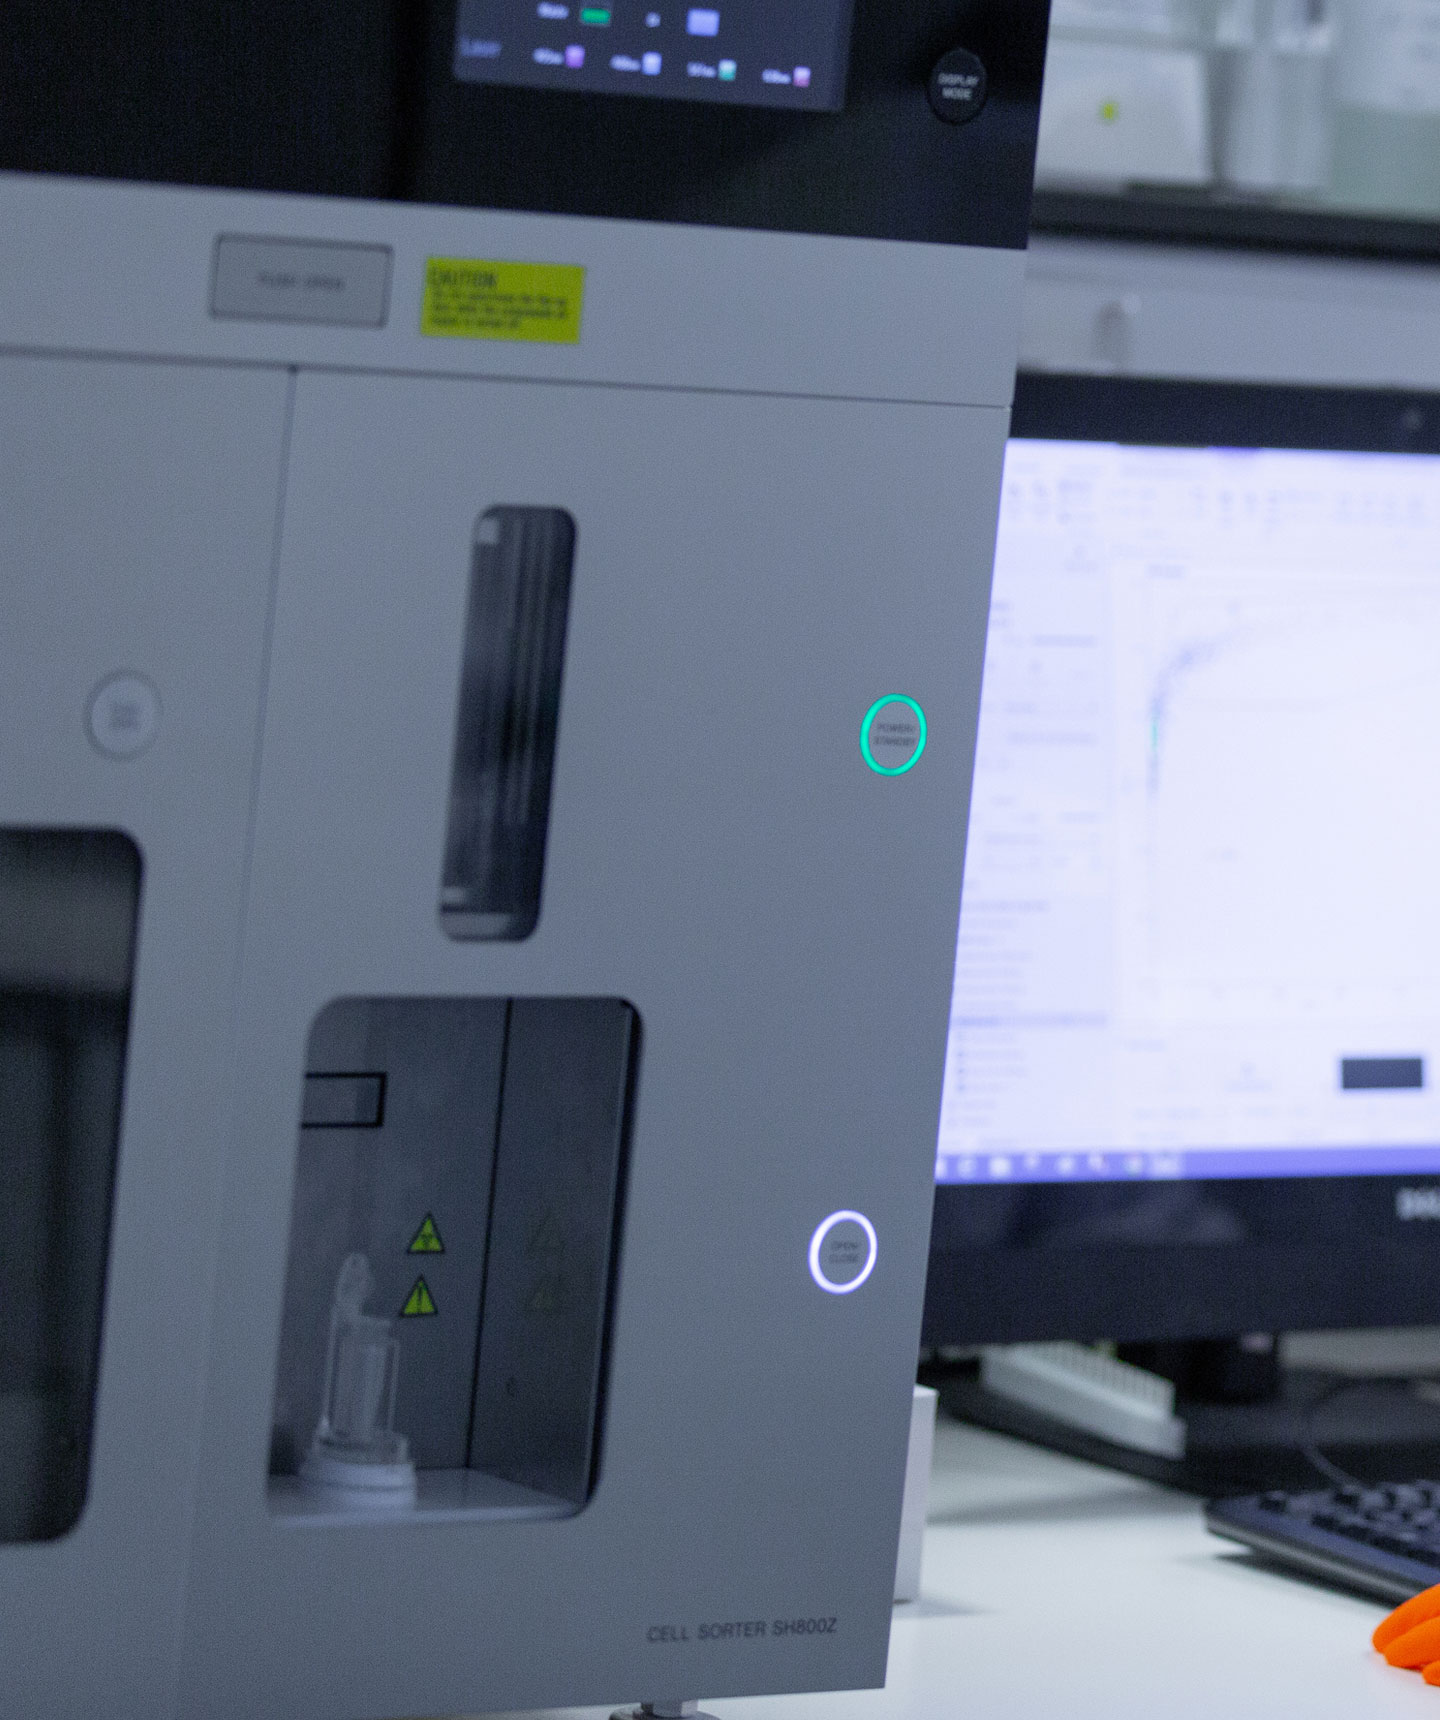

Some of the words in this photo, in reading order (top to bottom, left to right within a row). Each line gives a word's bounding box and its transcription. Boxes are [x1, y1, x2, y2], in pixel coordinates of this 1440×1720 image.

[938, 73, 980, 88] DISPLAY
[942, 87, 973, 100] MODE
[646, 1624, 689, 1643] CELL
[698, 1621, 767, 1640] SORTER
[773, 1617, 838, 1636] SH800Z
